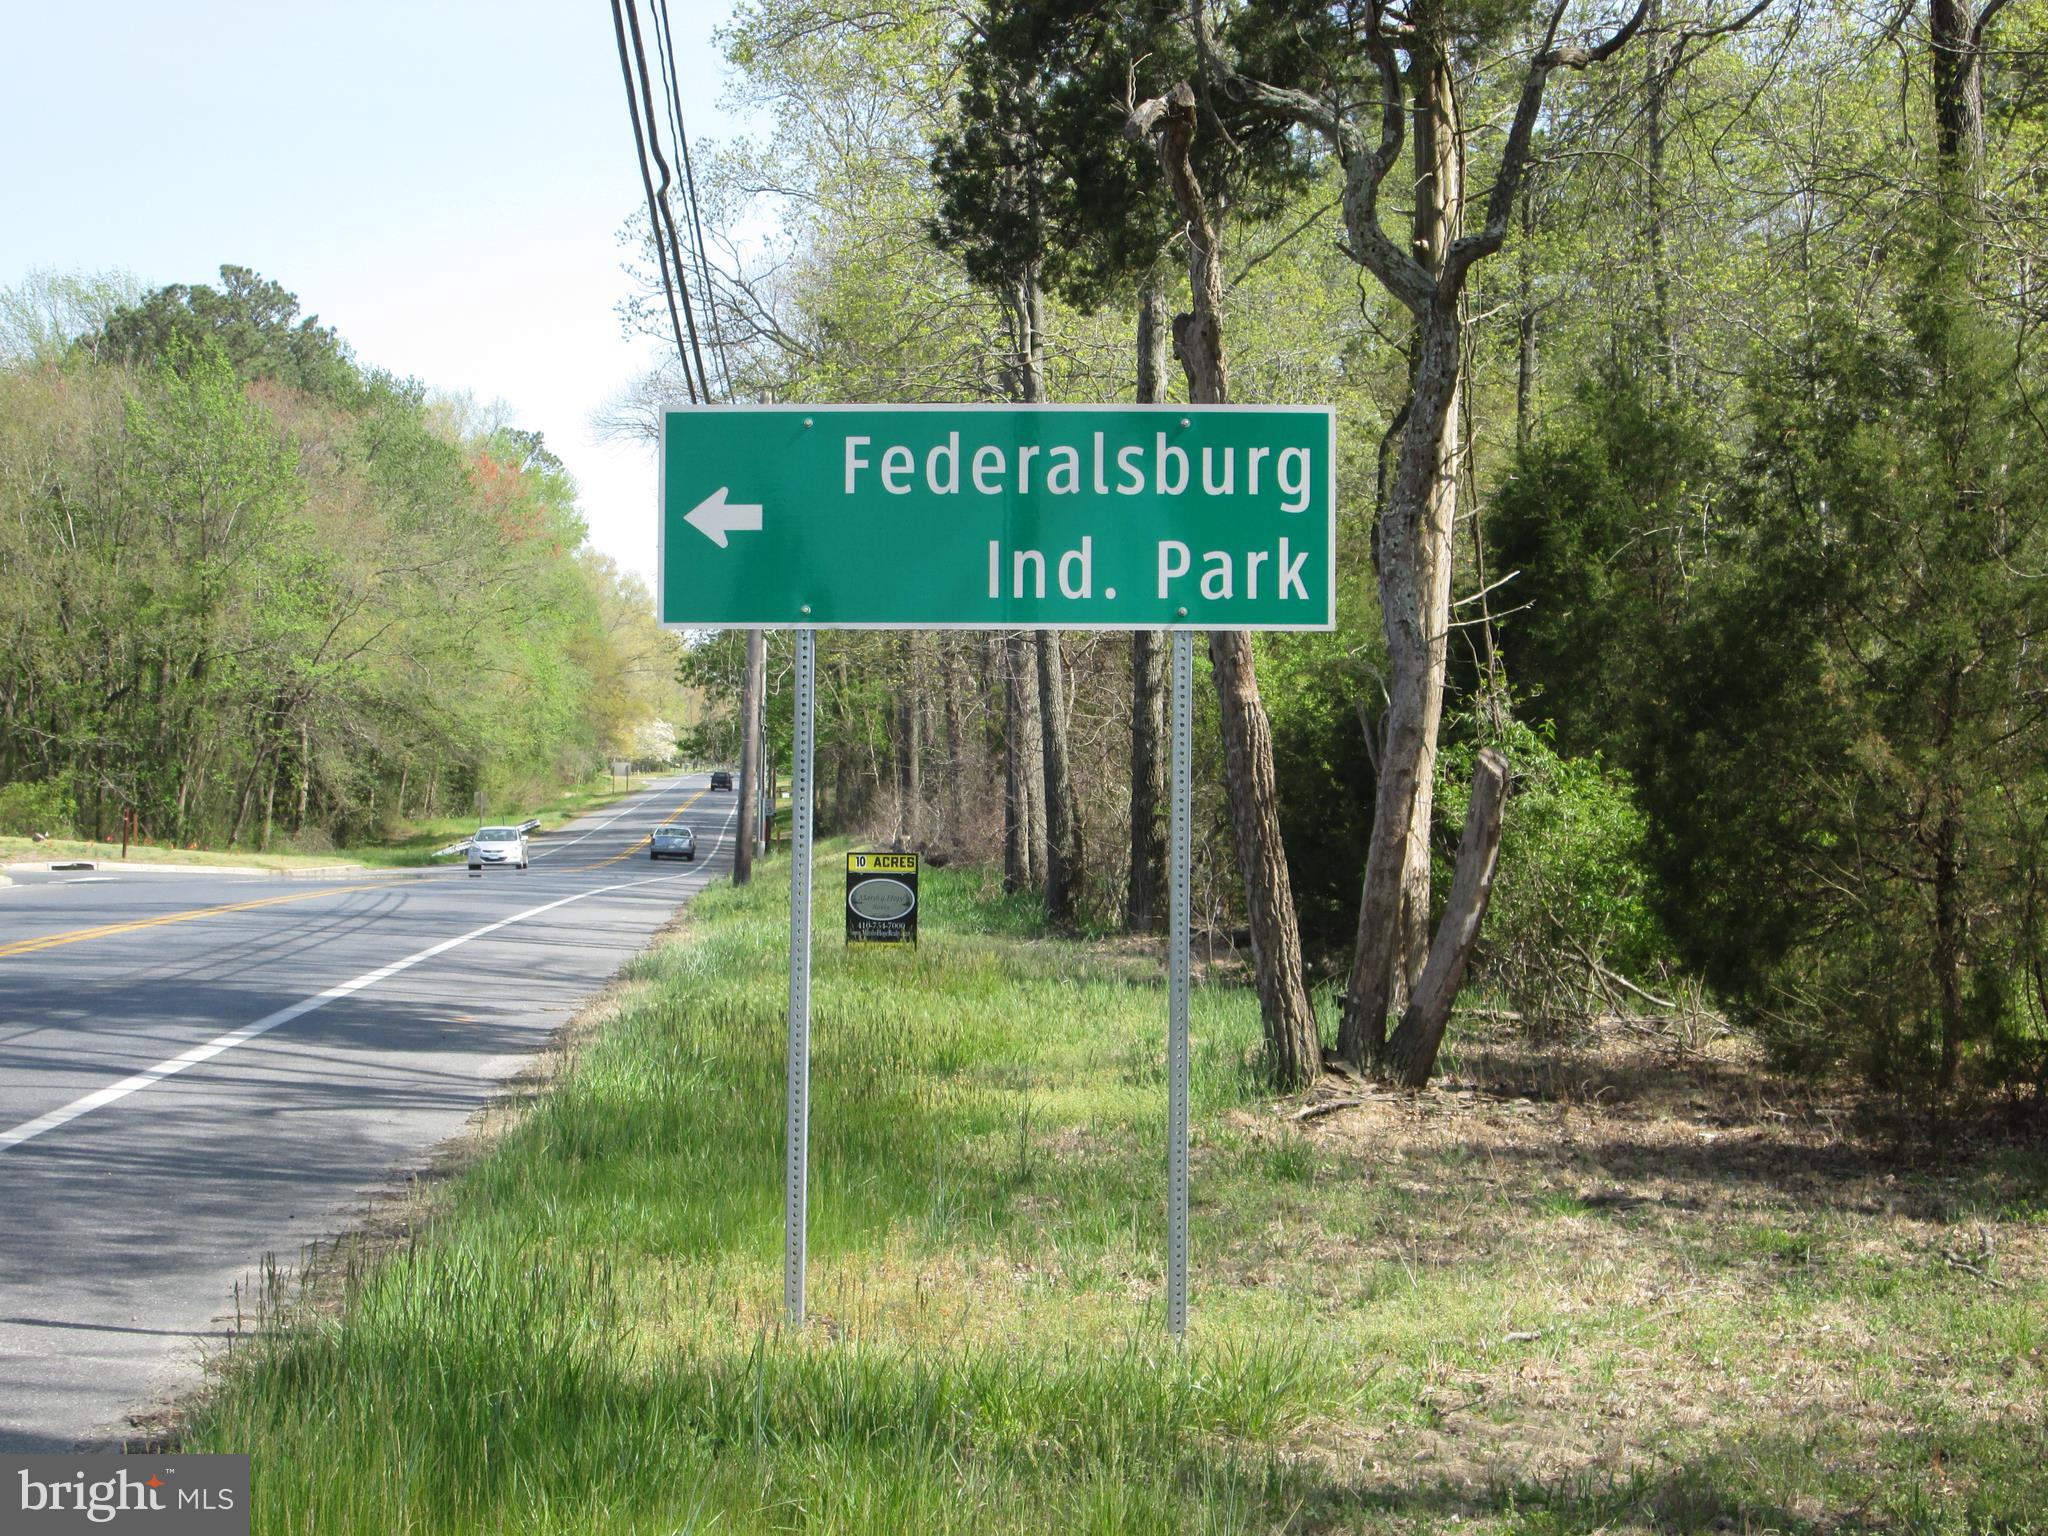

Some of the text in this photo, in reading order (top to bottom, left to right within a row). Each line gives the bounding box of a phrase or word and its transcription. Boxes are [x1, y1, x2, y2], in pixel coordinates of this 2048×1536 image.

[845, 431, 1311, 513] Federalsburg
[989, 536, 1309, 600] Ind. Park
[855, 856, 915, 868] 10 ACRES
